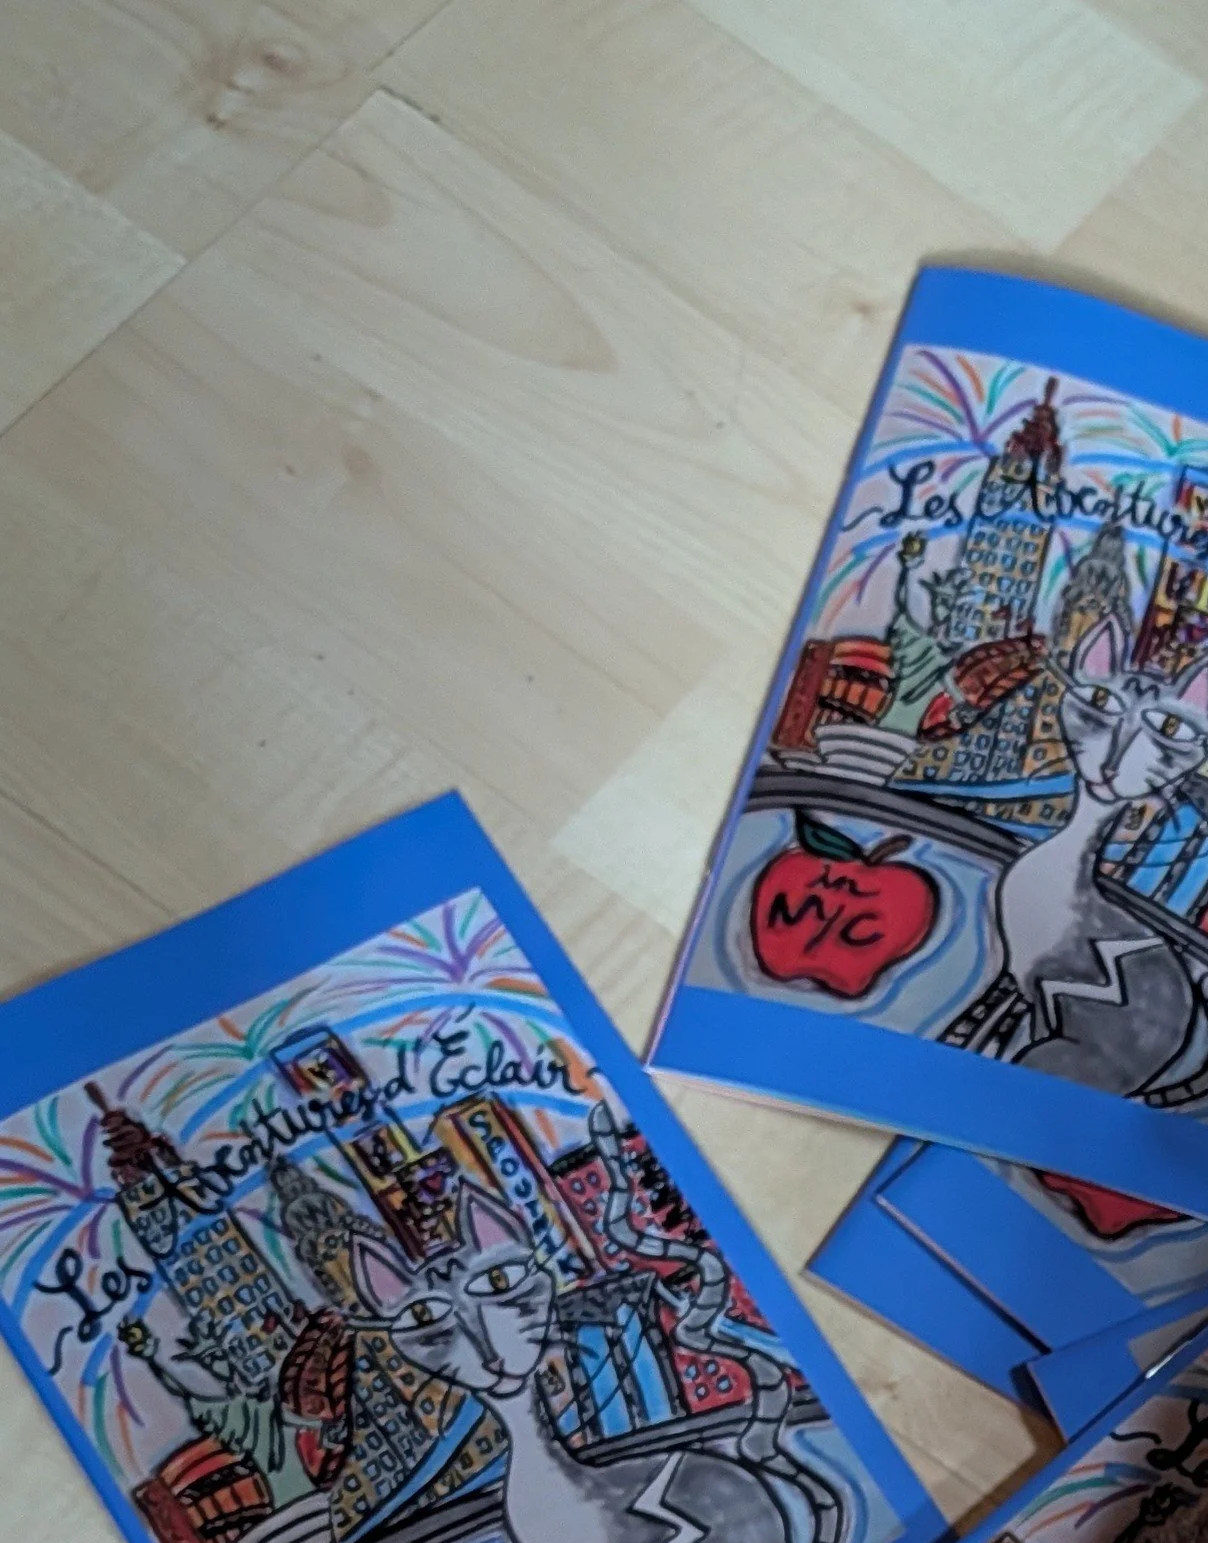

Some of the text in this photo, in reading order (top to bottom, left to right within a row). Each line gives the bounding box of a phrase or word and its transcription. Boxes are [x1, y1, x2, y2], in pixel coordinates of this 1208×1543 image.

[878, 460, 964, 528] Les
[804, 864, 882, 897] in
[767, 892, 886, 955] NYC
[36, 1250, 154, 1342] Les
[134, 1086, 388, 1250] Aventures
